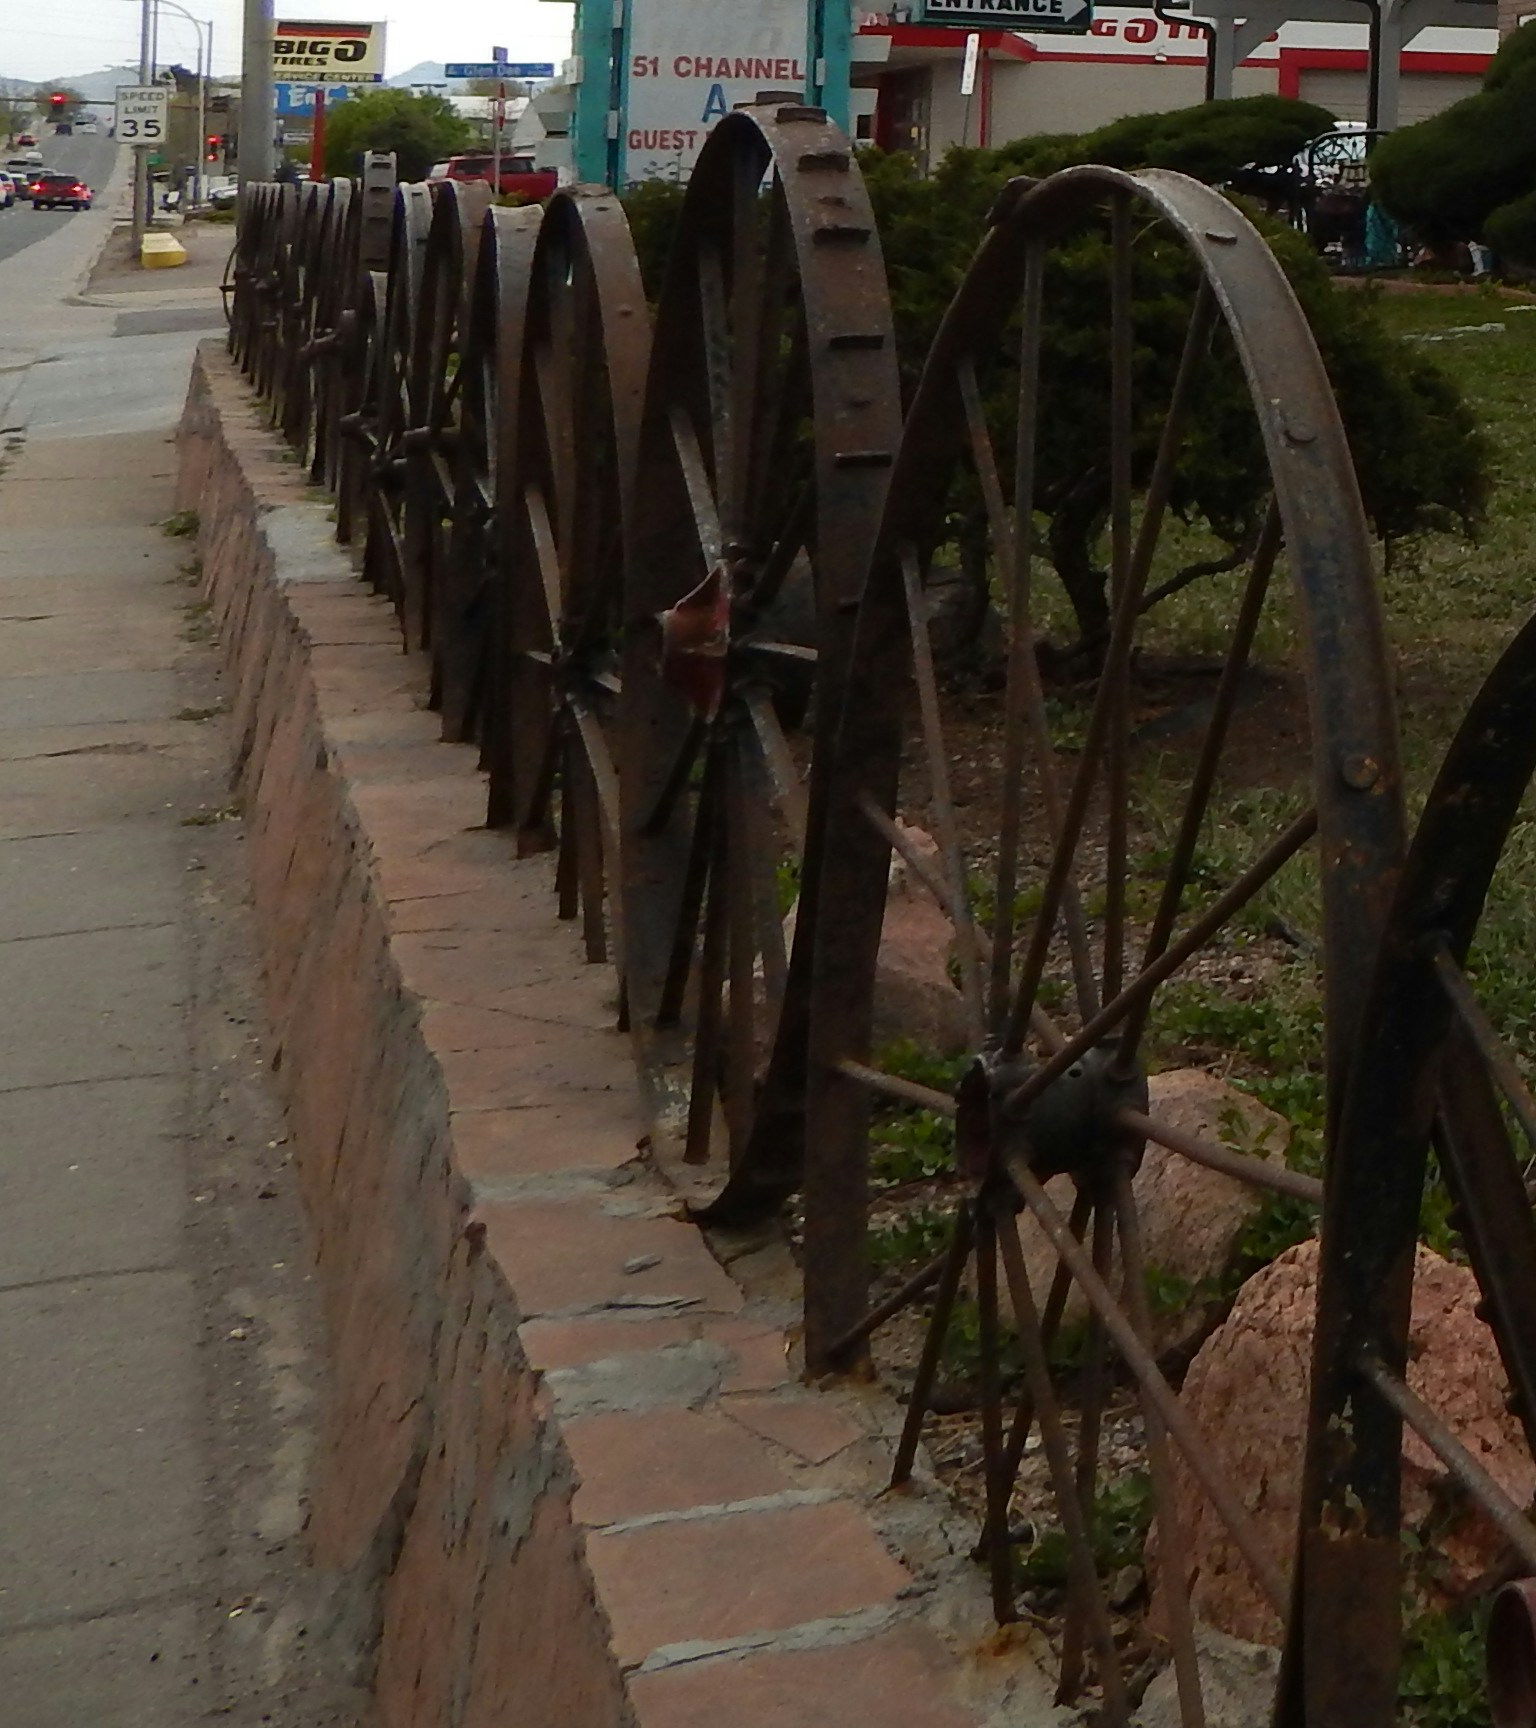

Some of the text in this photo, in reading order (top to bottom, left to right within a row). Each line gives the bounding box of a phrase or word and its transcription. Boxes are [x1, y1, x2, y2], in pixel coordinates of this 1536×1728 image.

[274, 40, 332, 55] BIG
[632, 56, 805, 80] 51 CHANNEL
[120, 91, 165, 101] SPEED
[124, 105, 159, 114] LIMIT
[121, 119, 161, 138] 35
[629, 130, 699, 151] GUEST
